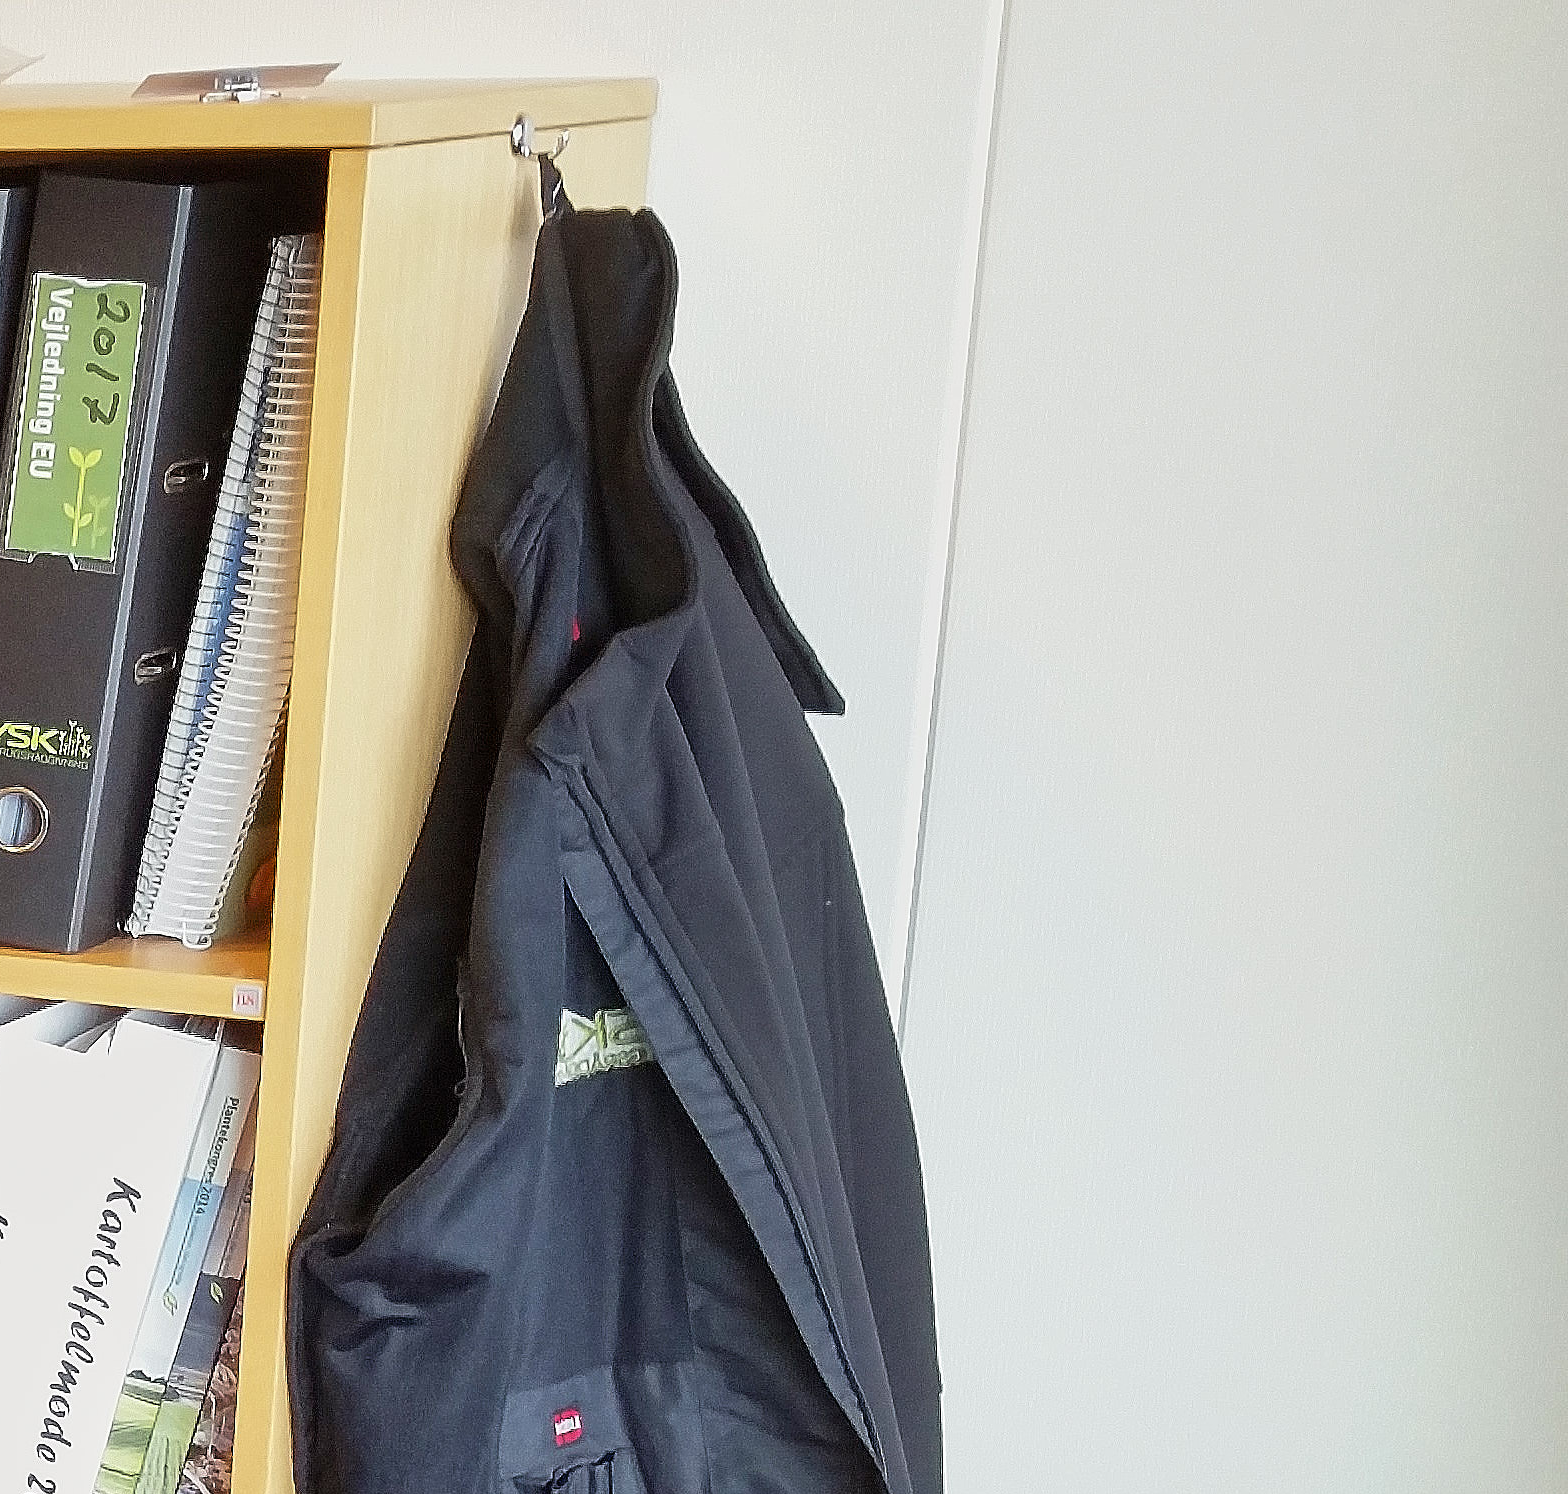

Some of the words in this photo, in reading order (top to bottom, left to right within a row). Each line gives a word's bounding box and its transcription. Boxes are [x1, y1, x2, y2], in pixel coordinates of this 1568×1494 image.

[29, 288, 75, 434] Vejledning
[82, 292, 130, 425] 2017
[29, 441, 56, 479] EU
